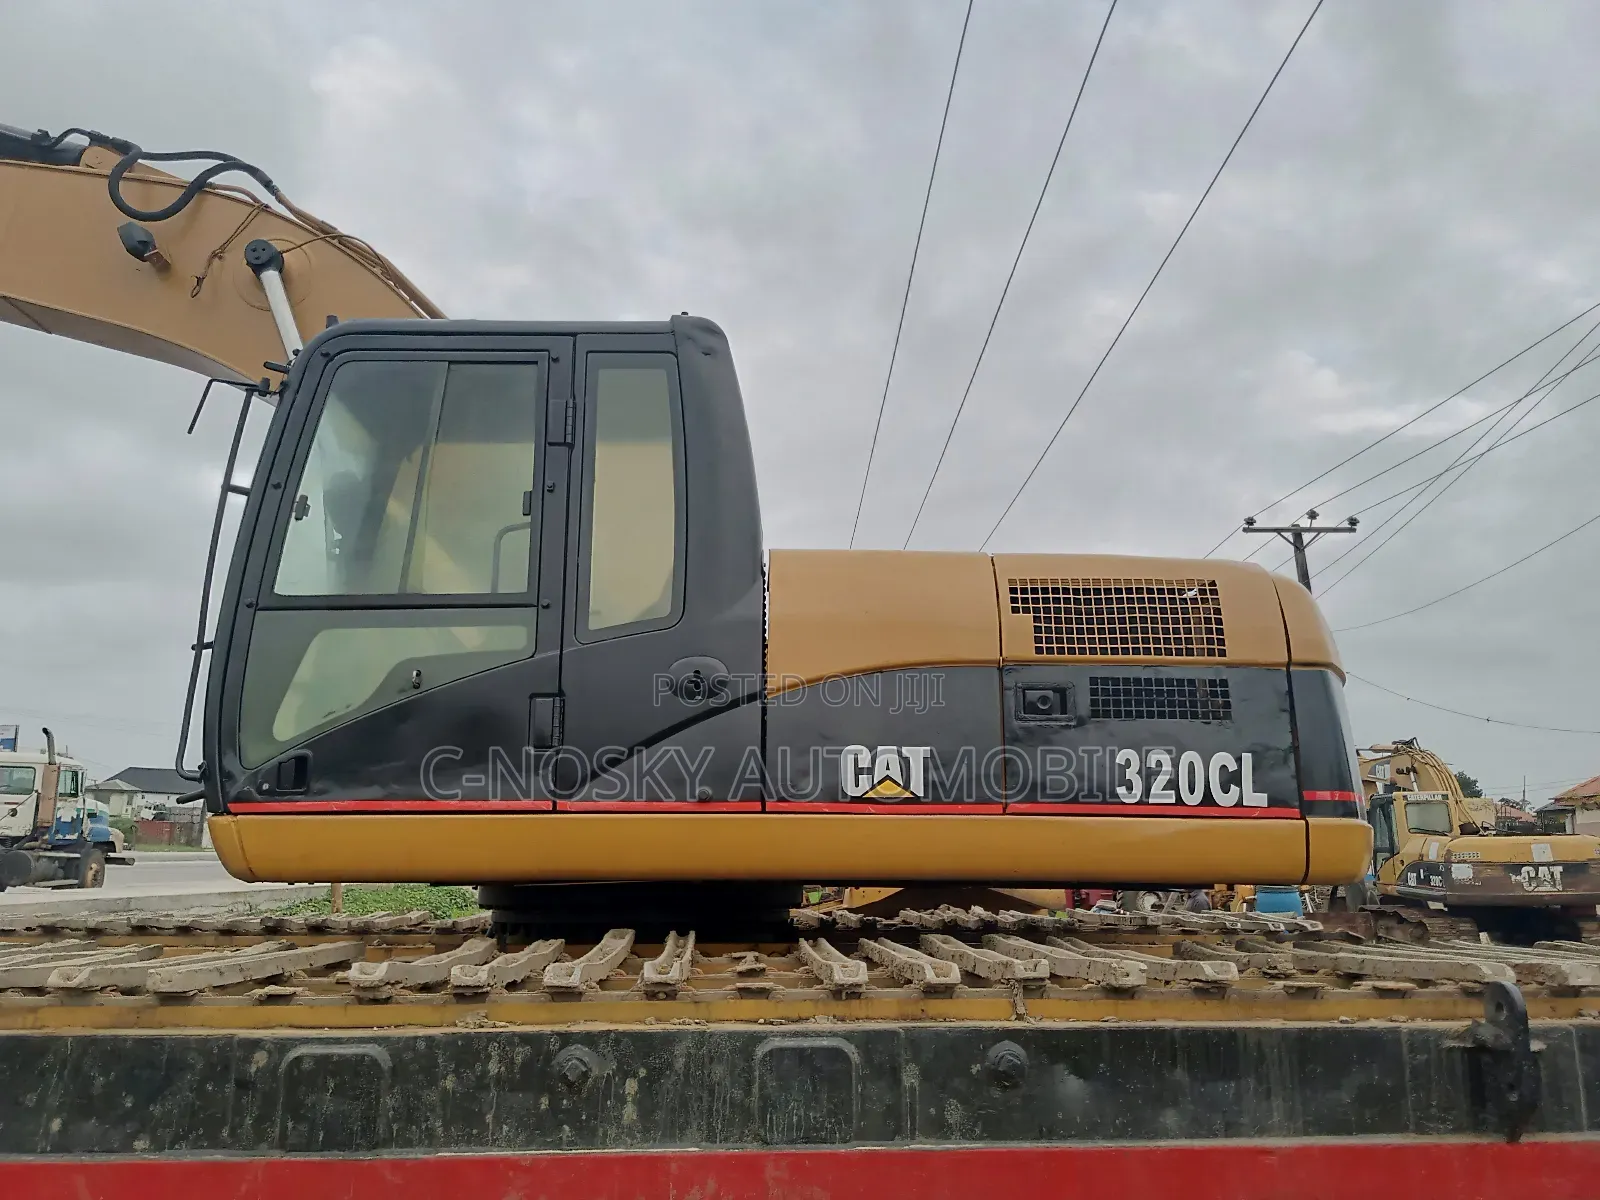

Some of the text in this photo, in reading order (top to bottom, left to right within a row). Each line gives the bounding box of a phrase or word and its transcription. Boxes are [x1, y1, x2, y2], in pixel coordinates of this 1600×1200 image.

[841, 744, 931, 798] CAT
[1115, 748, 1268, 808] 320CL
[1521, 865, 1564, 892] CAT
